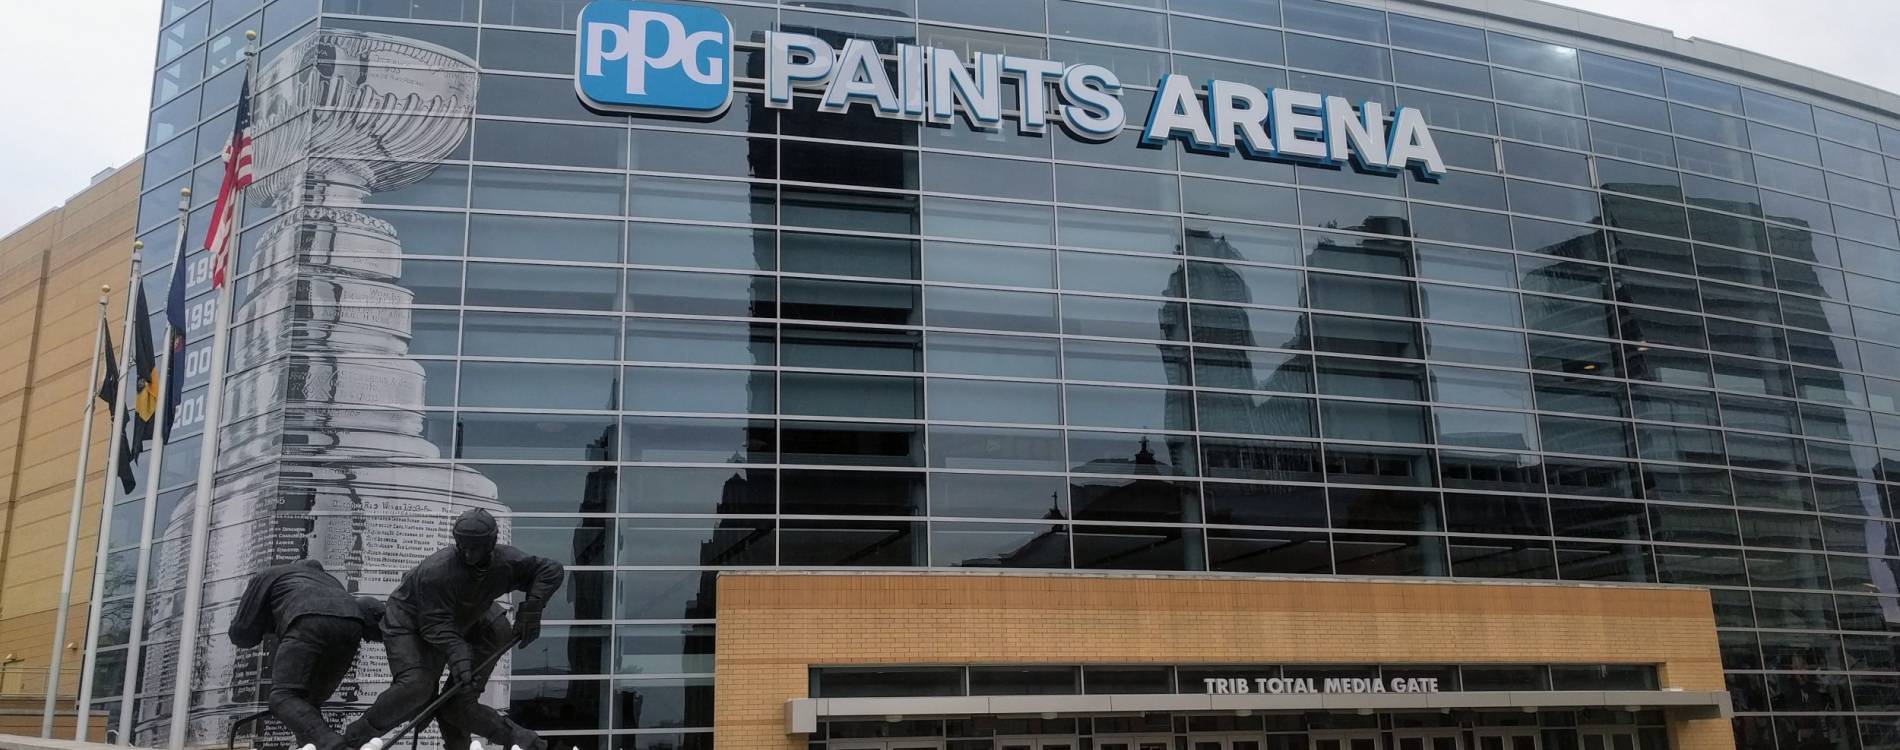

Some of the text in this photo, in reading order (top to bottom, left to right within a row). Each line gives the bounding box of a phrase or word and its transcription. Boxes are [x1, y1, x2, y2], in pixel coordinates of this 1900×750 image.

[586, 9, 723, 96] PPG
[765, 30, 1447, 178] PAINTS ARENA
[186, 298, 219, 332] 199
[173, 395, 205, 429] 201
[1204, 678, 1439, 694] TRIB TOTAL MEDIA GATE
